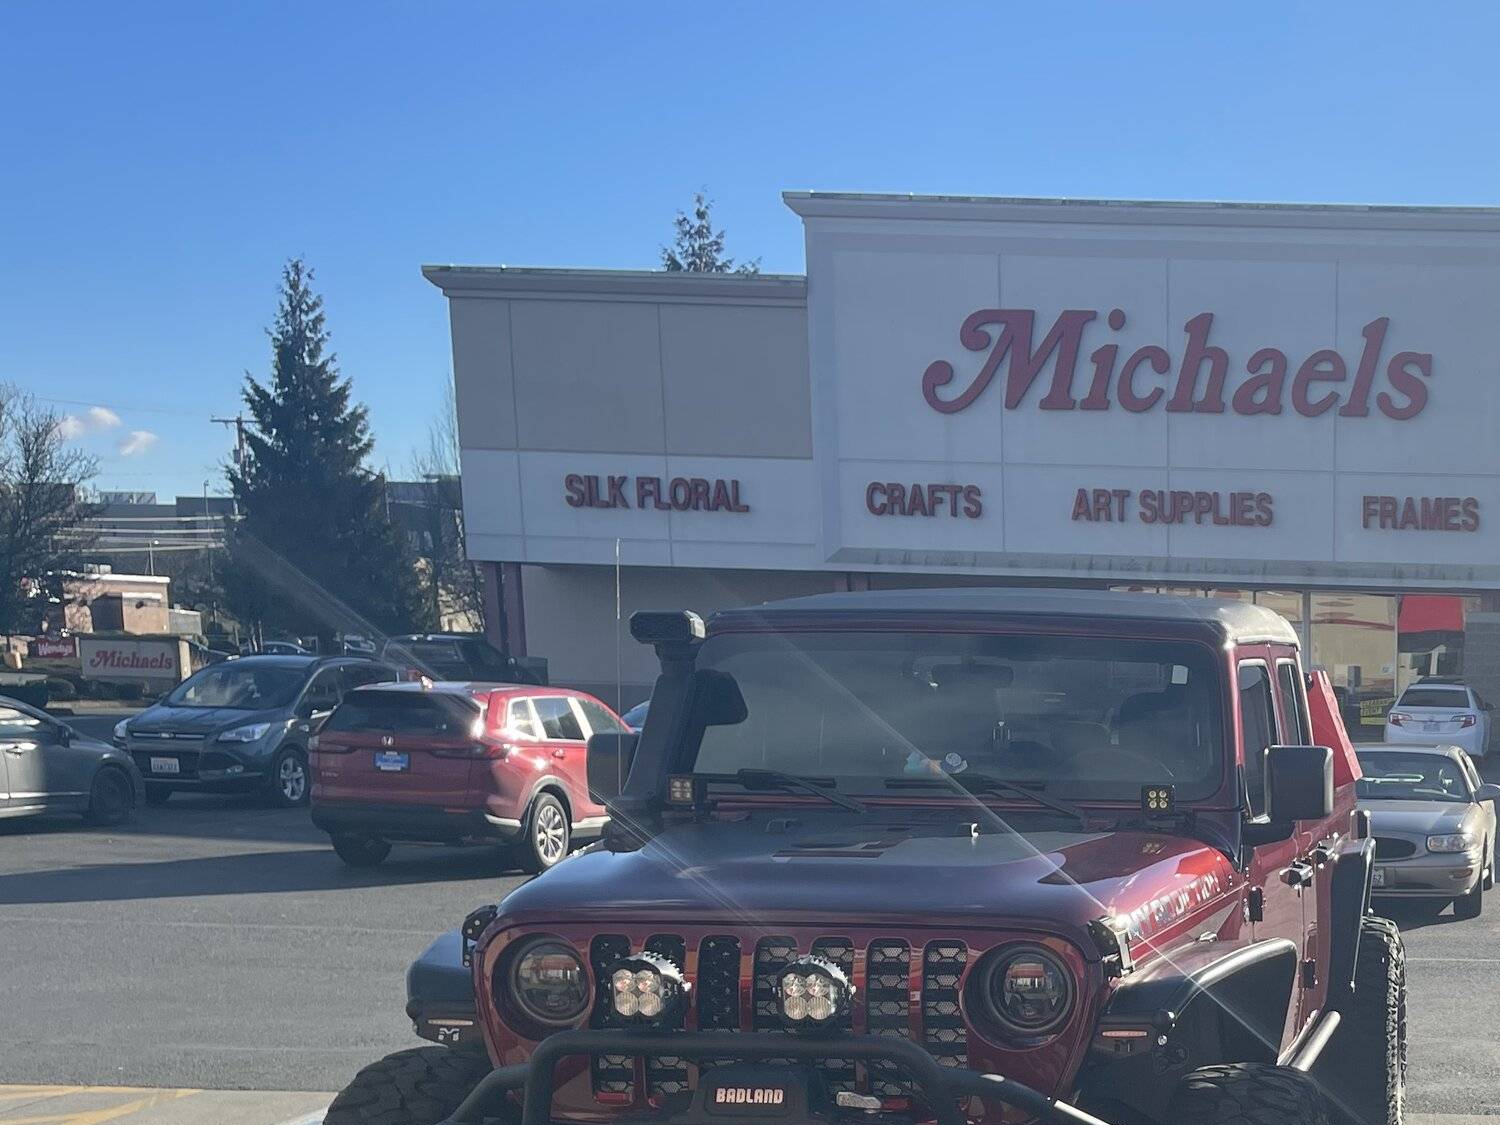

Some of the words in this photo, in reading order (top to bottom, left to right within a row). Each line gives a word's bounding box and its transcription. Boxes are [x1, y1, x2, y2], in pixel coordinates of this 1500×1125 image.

[922, 308, 1433, 420] Michaels
[565, 474, 629, 509] SILK
[636, 477, 750, 513] FLORAL
[866, 481, 982, 518] CRAFTS
[1072, 488, 1130, 522] ART
[1139, 489, 1273, 527] SUPPLIES
[1362, 496, 1479, 532] FRAMES
[89, 650, 173, 669] Michaels
[715, 1087, 784, 1104] BADLAND
